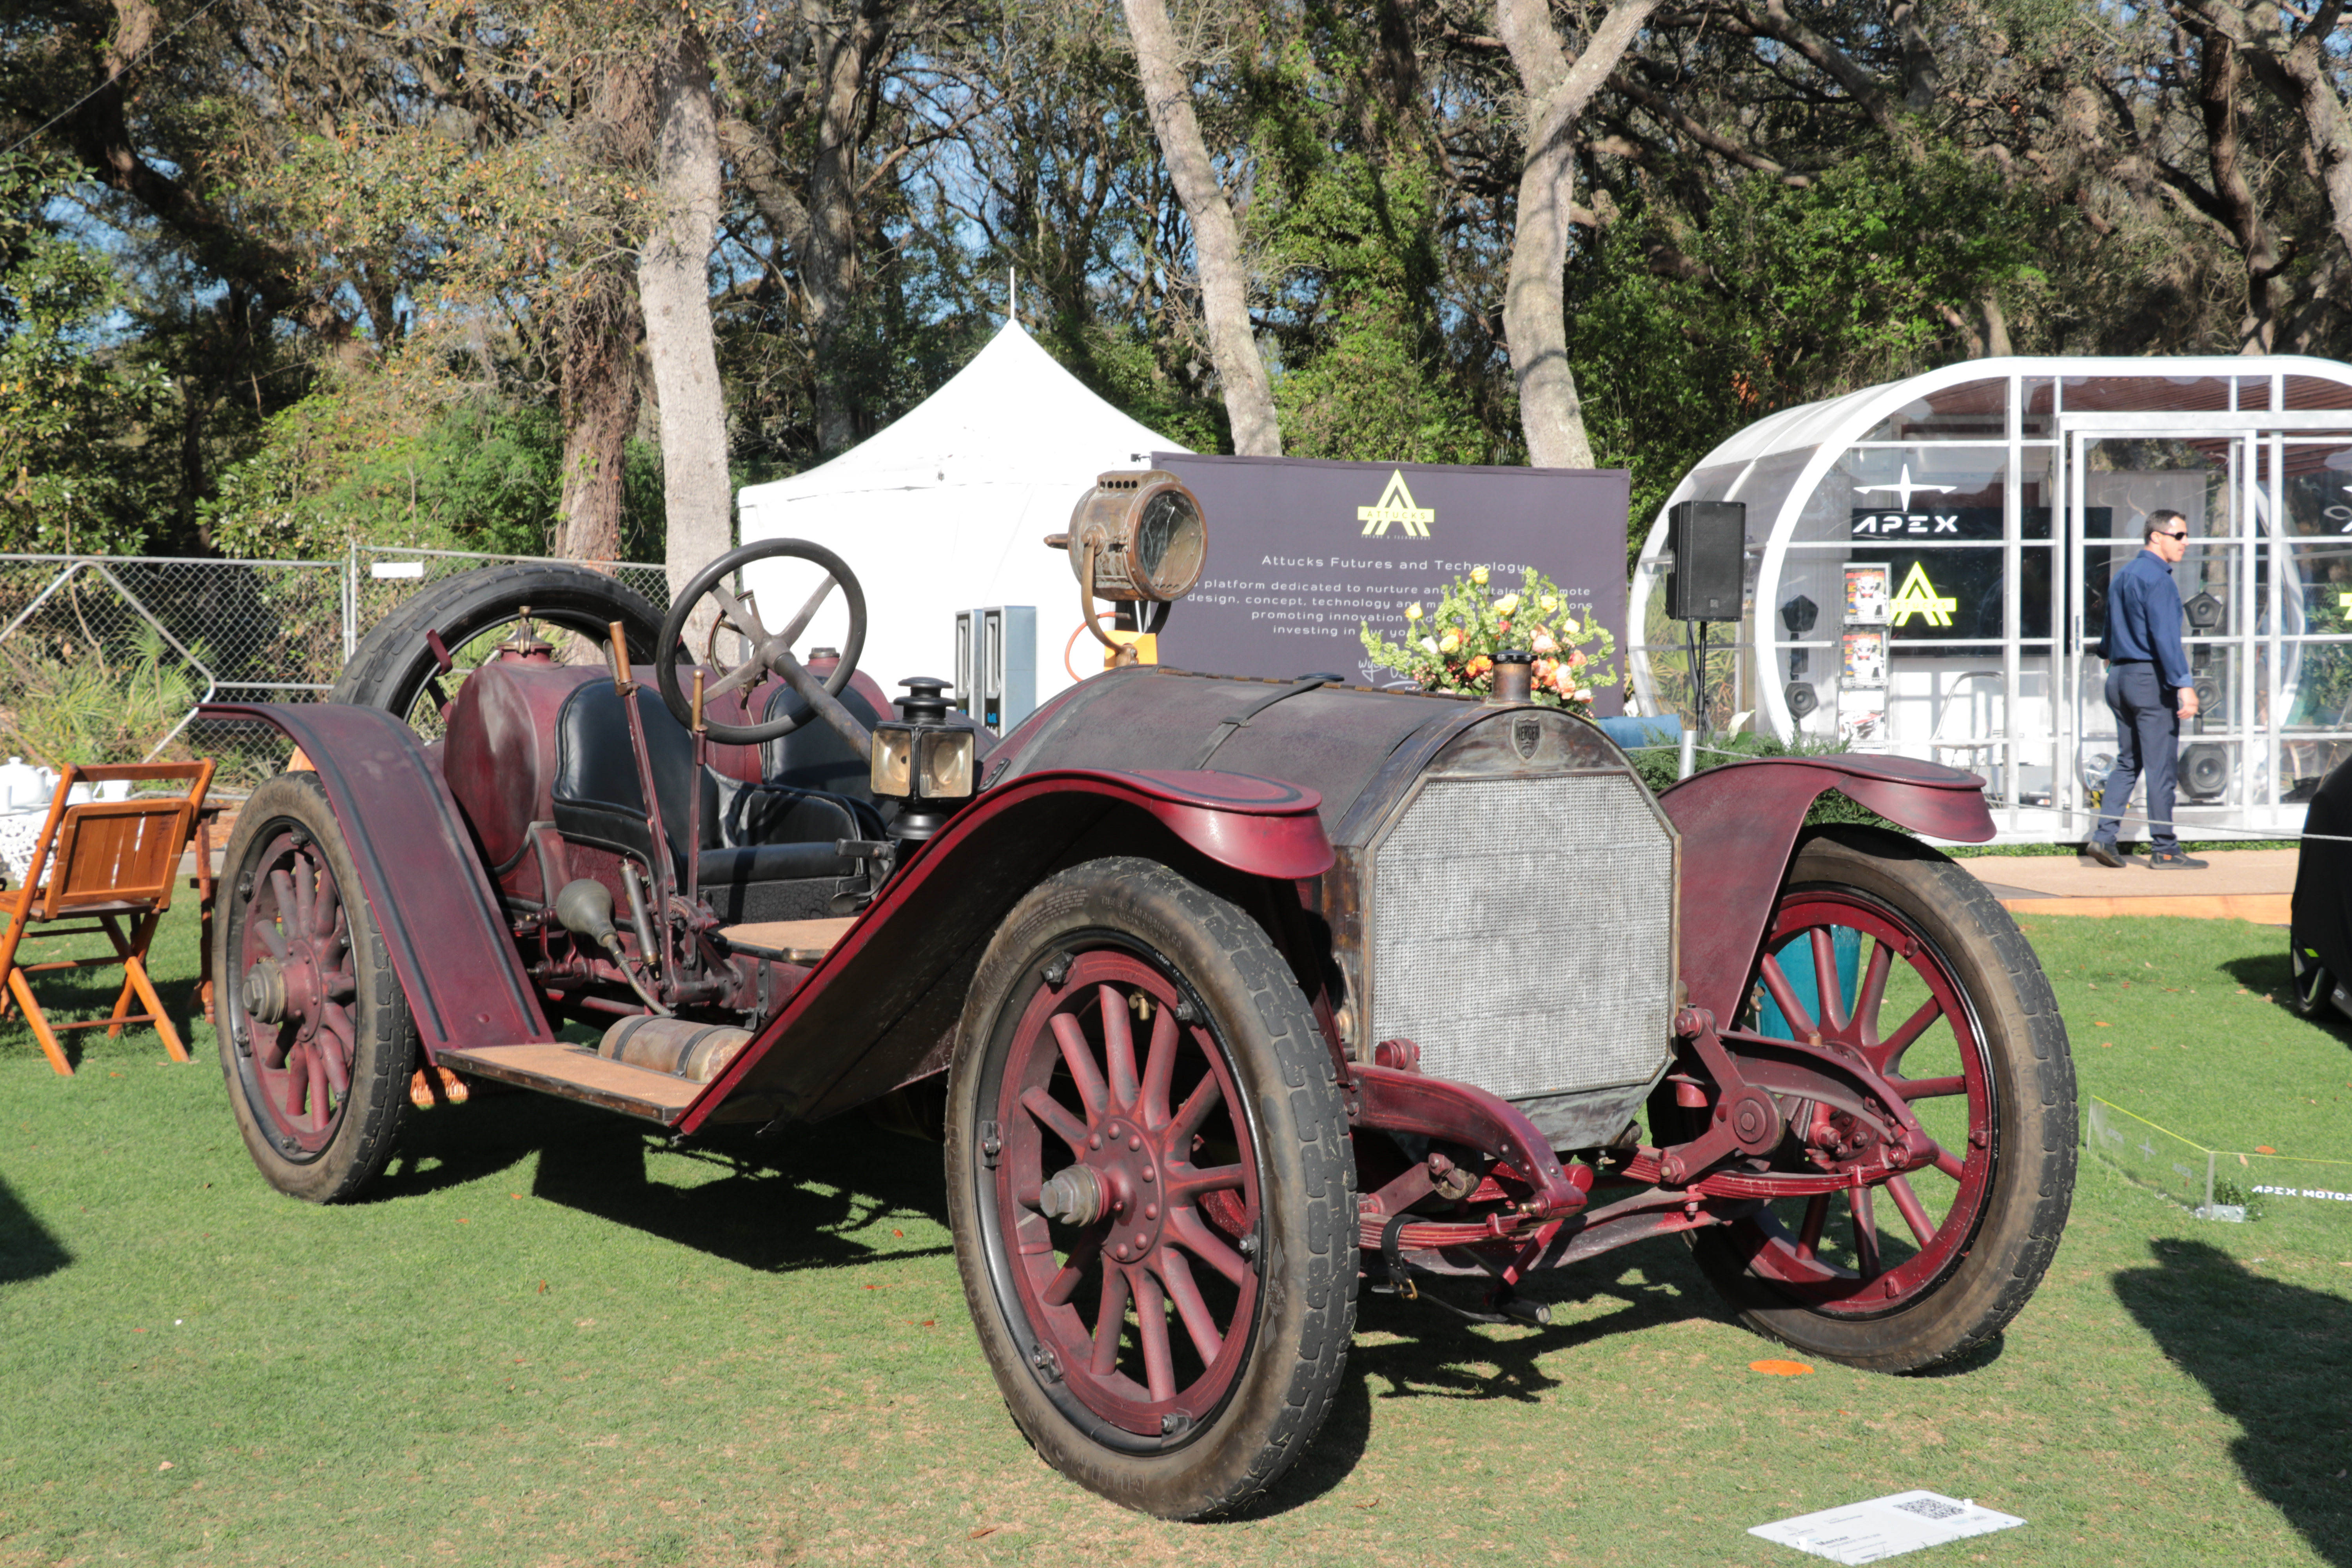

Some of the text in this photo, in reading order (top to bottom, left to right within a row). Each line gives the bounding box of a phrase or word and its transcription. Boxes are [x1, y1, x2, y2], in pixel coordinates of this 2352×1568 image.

[1367, 511, 1425, 519] ATTUCKS
[1852, 515, 1958, 532] APEX
[1262, 555, 1525, 573] Attucks Futures and Technology
[1205, 579, 1265, 590] platform
[1271, 581, 1341, 592] dedicated
[1347, 584, 1360, 592] to
[1367, 586, 1418, 594] nurture
[1492, 587, 1524, 595] talen
[1188, 593, 1239, 604] design,
[1246, 596, 1307, 607] concept,
[1312, 597, 1390, 609] technology
[1252, 611, 1403, 622] promoting innovation
[1274, 625, 1338, 637] investing
[1516, 726, 1539, 741] MERCER
[2251, 1185, 2297, 1196] APEX
